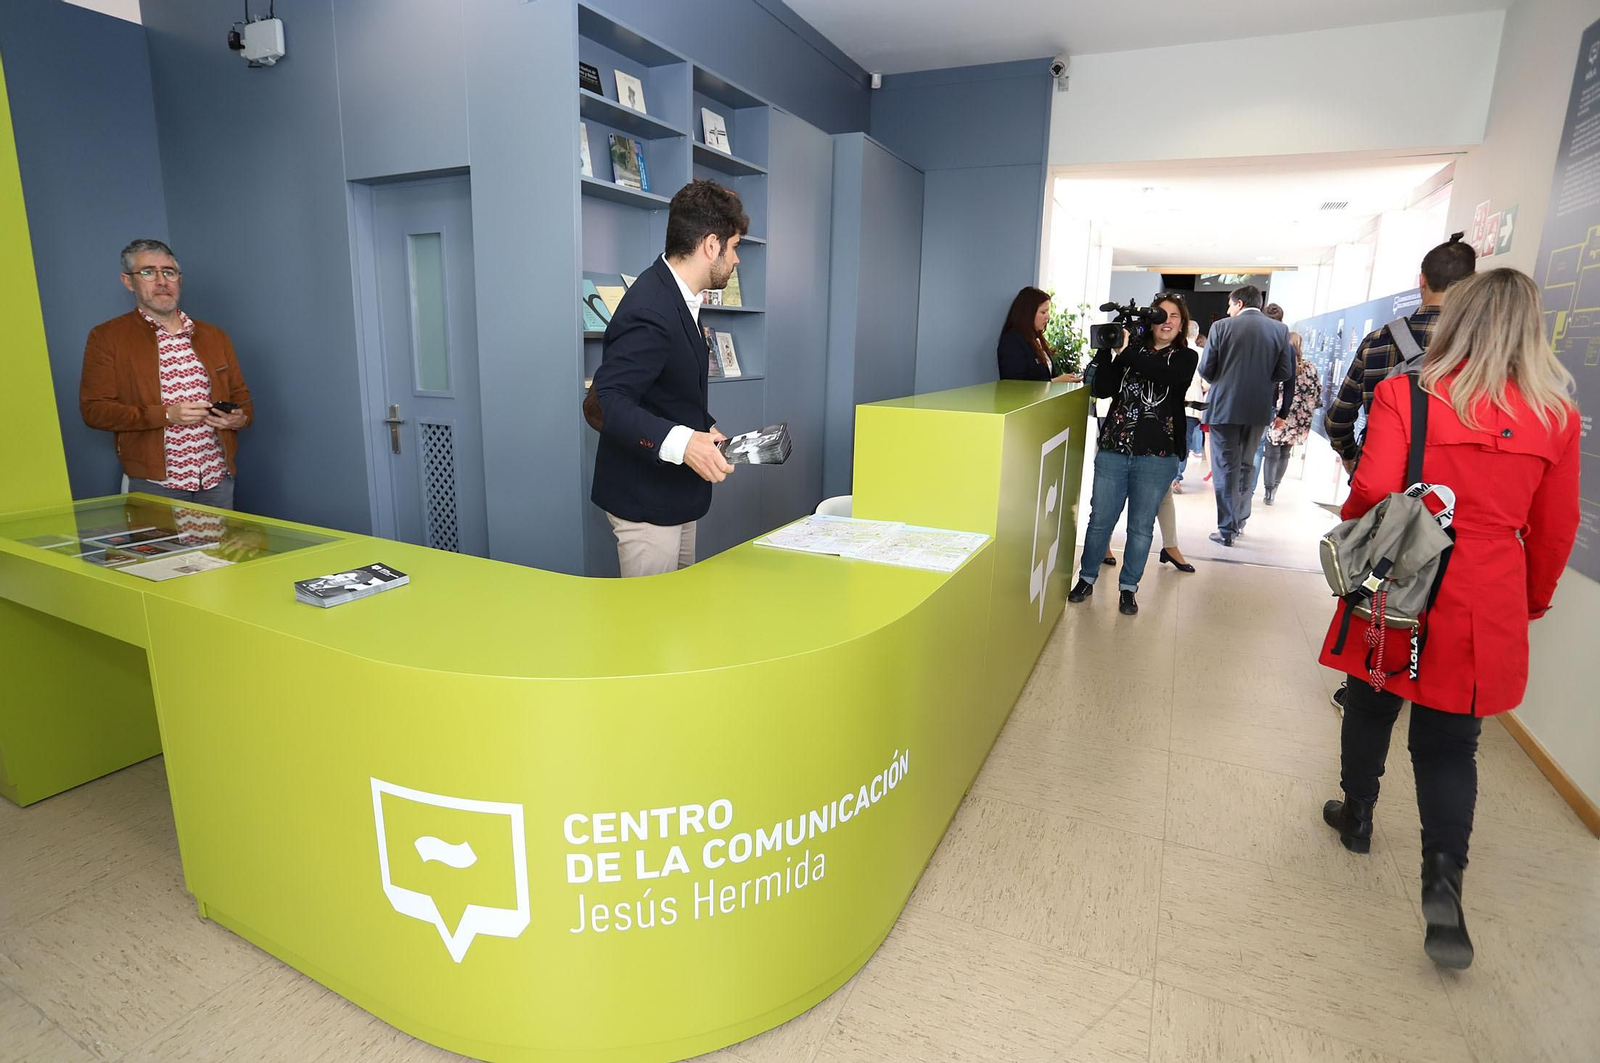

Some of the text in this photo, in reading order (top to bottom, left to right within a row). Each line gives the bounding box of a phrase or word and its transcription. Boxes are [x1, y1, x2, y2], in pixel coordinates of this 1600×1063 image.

[563, 798, 733, 845] CENTRO
[565, 748, 909, 884] DE LA COMUNICACIÓN
[569, 849, 826, 934] Jesús Hermida
